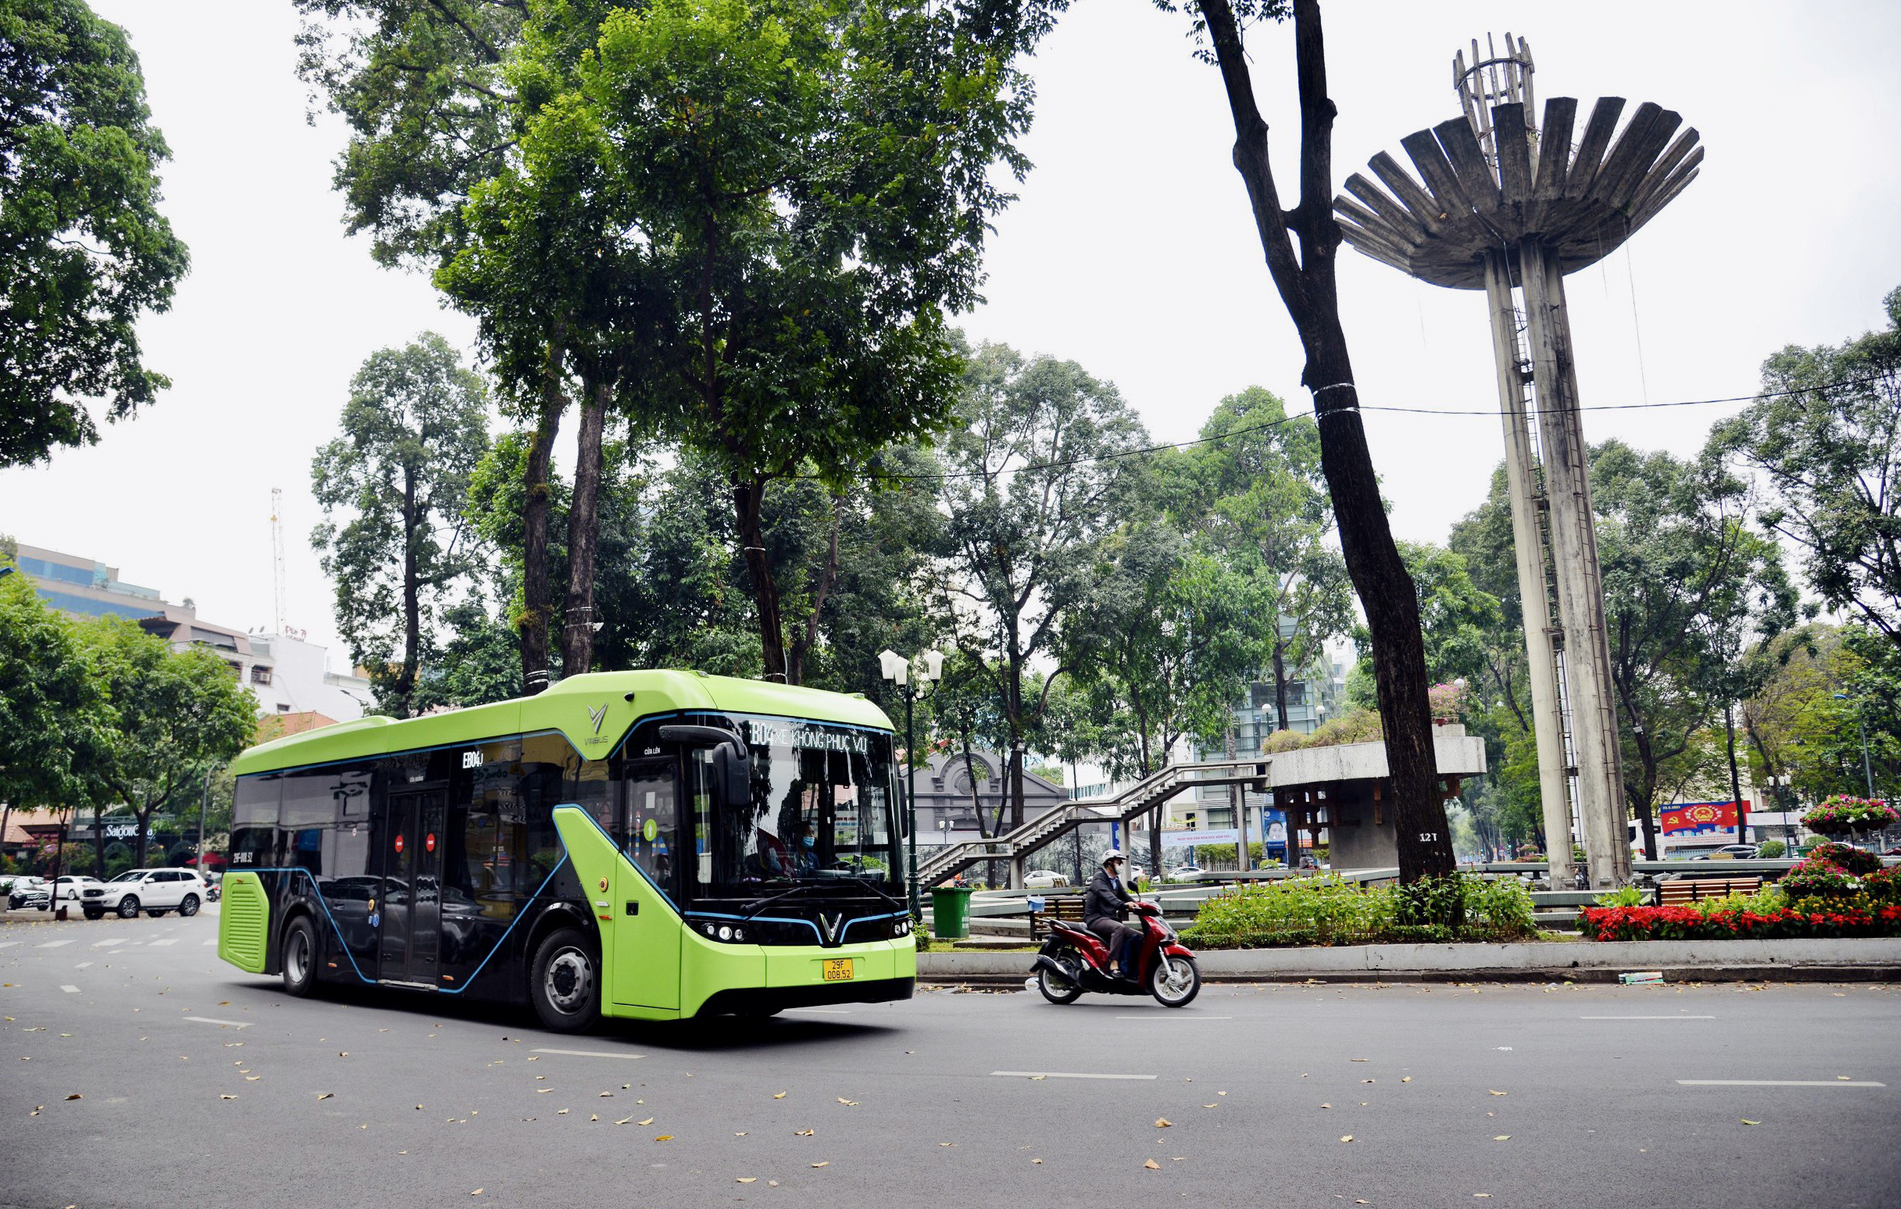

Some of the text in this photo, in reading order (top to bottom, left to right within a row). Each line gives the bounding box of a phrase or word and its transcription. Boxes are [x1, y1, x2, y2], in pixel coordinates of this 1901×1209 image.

[775, 728, 789, 745] XE
[791, 728, 824, 748] KHÔNG
[826, 733, 850, 753] PHỤC
[832, 961, 844, 969] 29F
[828, 970, 850, 979] 008.52
